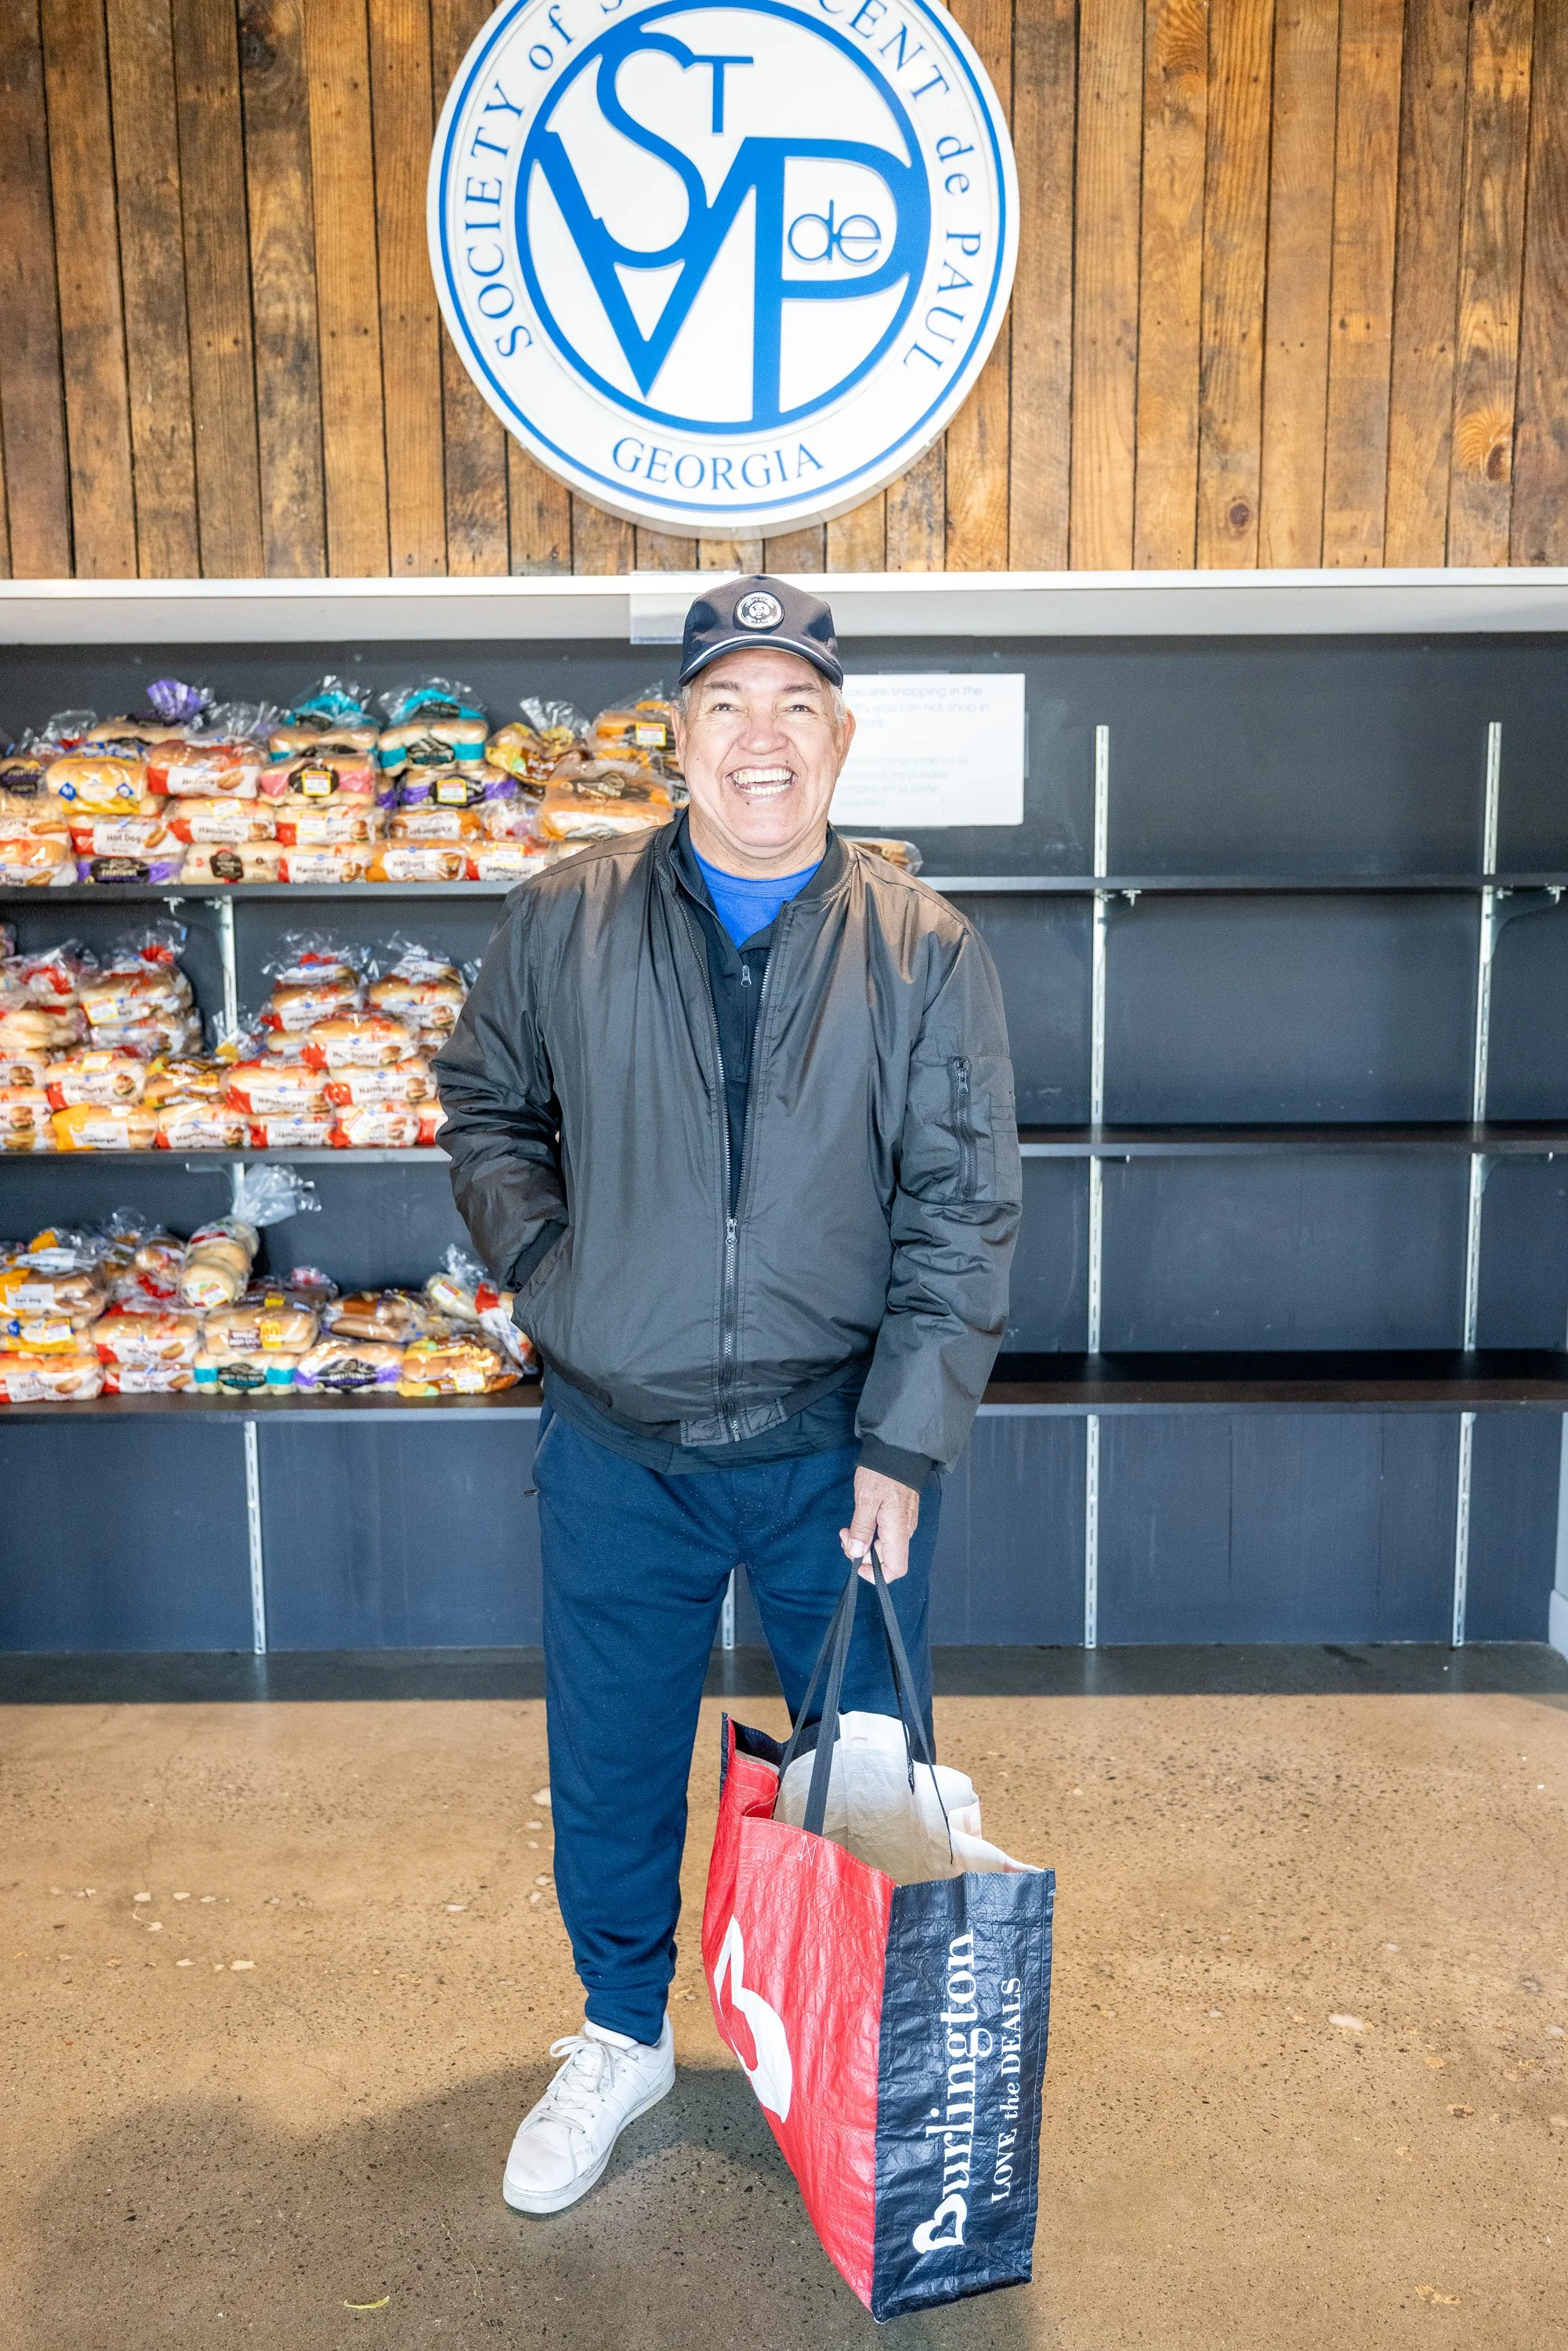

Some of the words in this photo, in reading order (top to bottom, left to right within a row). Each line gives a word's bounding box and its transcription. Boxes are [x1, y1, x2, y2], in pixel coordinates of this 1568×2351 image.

[528, 4, 577, 72] of
[935, 134, 978, 197] de
[464, 81, 533, 358] SOCIETY
[904, 232, 982, 371] PAUL
[611, 437, 824, 491] GEORGIA
[891, 685, 947, 698] shopping
[950, 685, 960, 696] in
[963, 685, 983, 696] the
[899, 702, 922, 713] can
[924, 701, 945, 713] not
[947, 701, 977, 715] shop
[979, 701, 990, 712] in
[1001, 1976, 1021, 2078] DEALS
[912, 1929, 994, 2254] Burlington
[999, 2081, 1021, 2121] the
[991, 2127, 1018, 2204] LOVE
